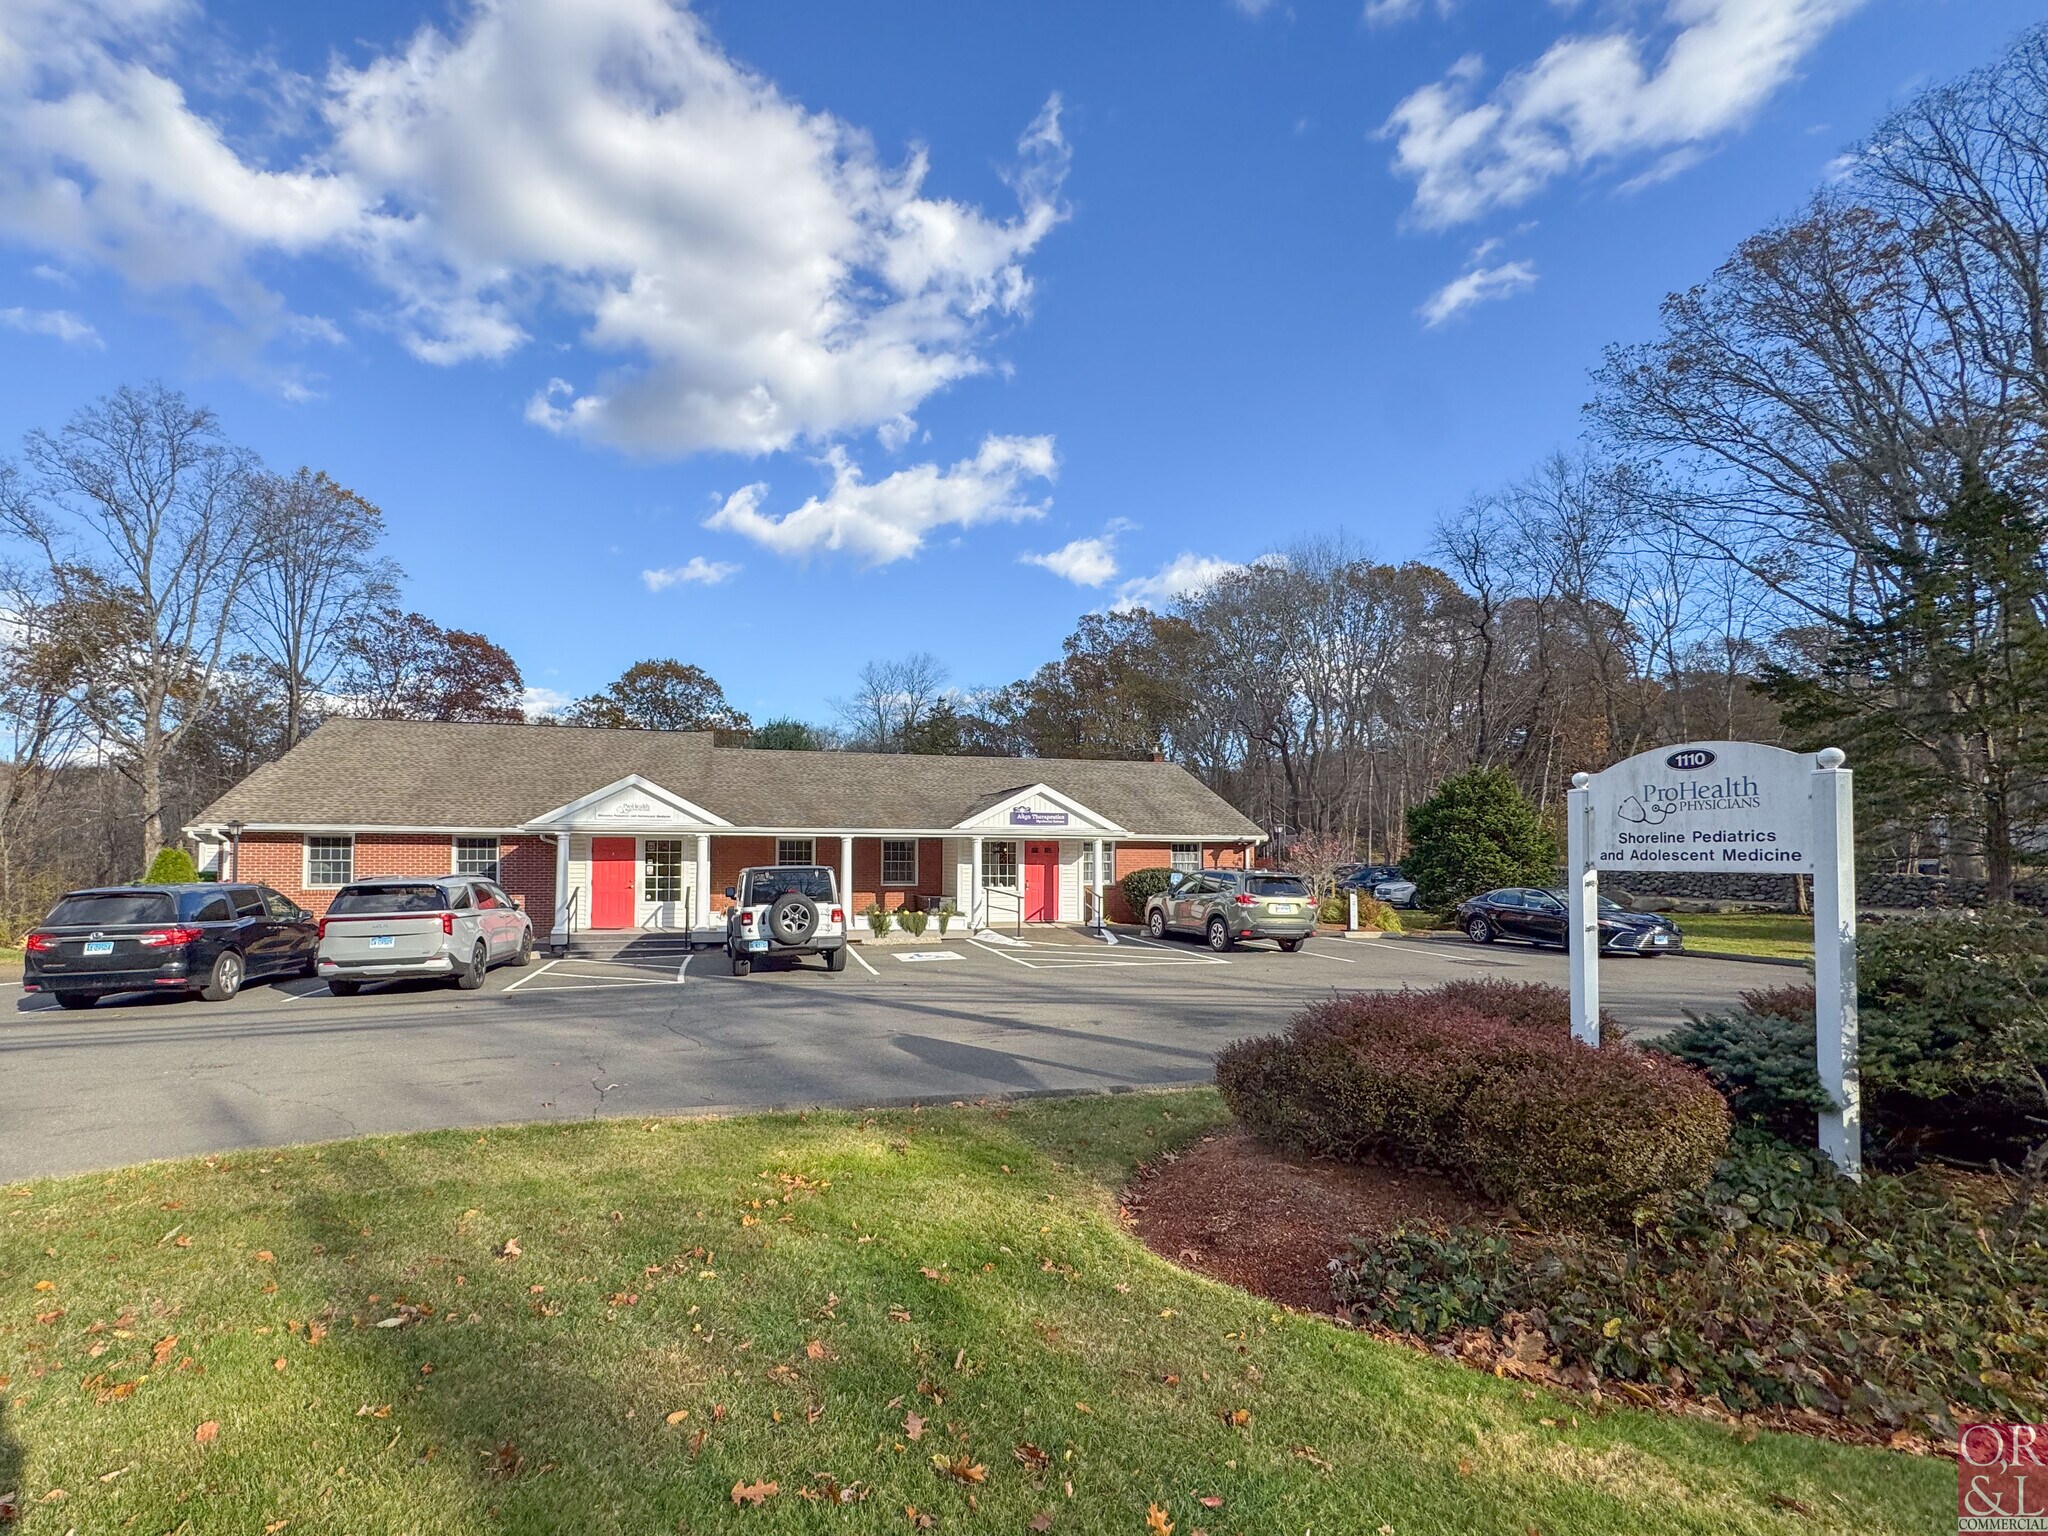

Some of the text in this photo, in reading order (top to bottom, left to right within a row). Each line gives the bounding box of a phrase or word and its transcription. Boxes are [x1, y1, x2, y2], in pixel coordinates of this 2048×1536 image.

[1675, 752, 1706, 767] 1110
[1643, 776, 1760, 802] ProHealth
[1680, 797, 1760, 811] PHYSICIANS
[1618, 830, 1777, 844] Shoreline Pediatrics
[1600, 848, 1802, 862] and Adolescent Medicine
